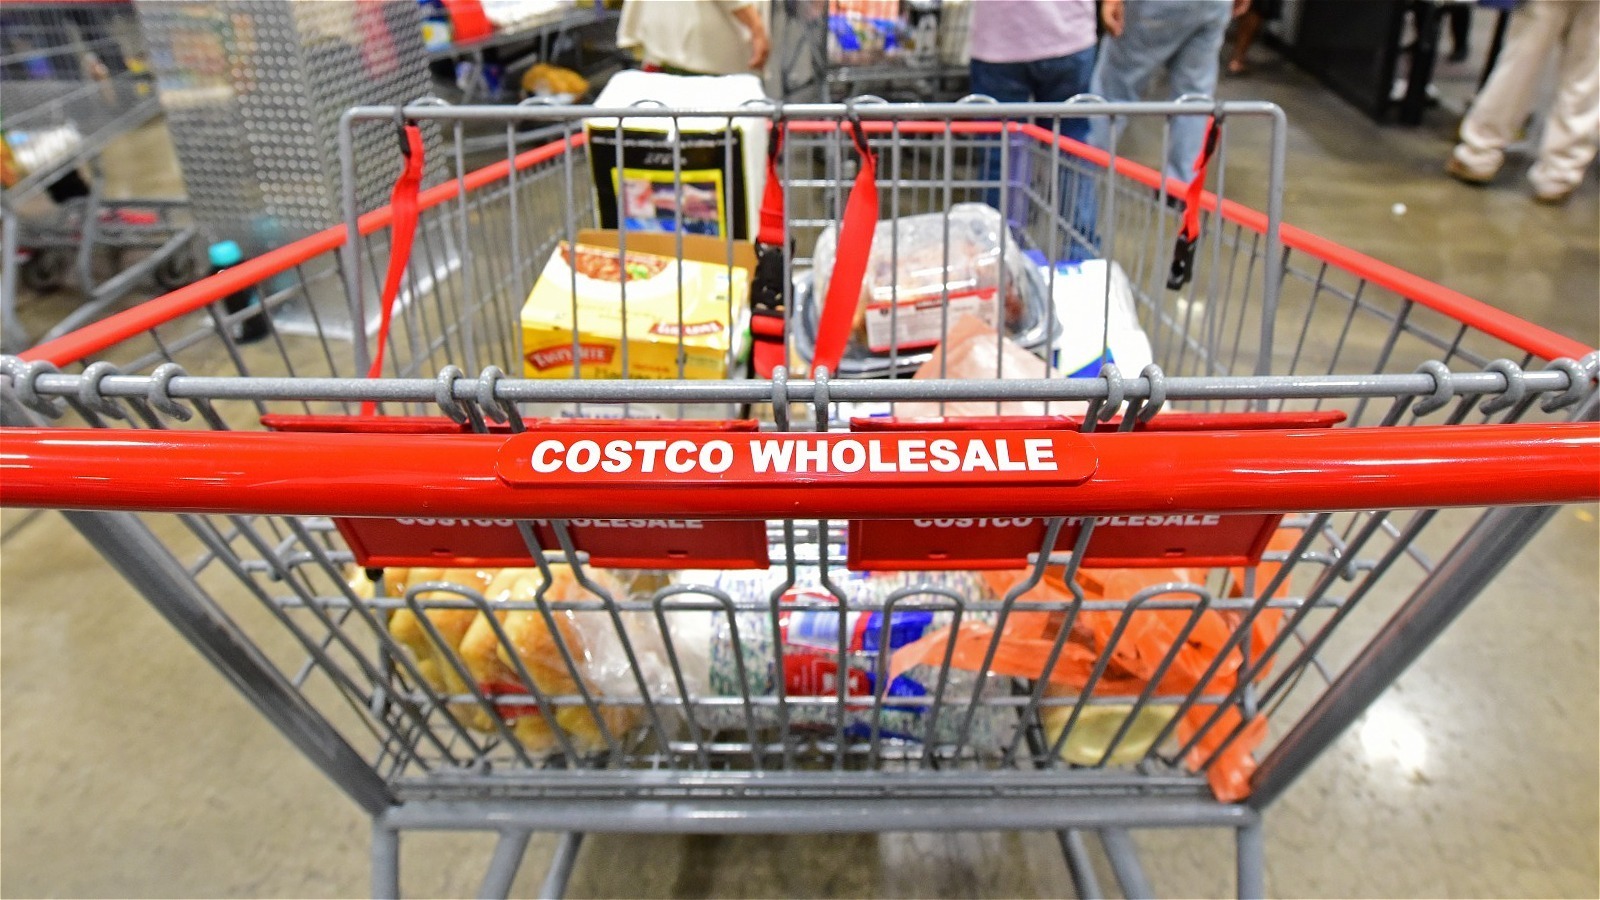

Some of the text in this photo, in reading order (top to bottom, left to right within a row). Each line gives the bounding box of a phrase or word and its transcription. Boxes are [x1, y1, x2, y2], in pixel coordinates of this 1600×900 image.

[531, 439, 1058, 473] COSTCO WHOLESALE
[1041, 514, 1220, 527] HOLESALE
